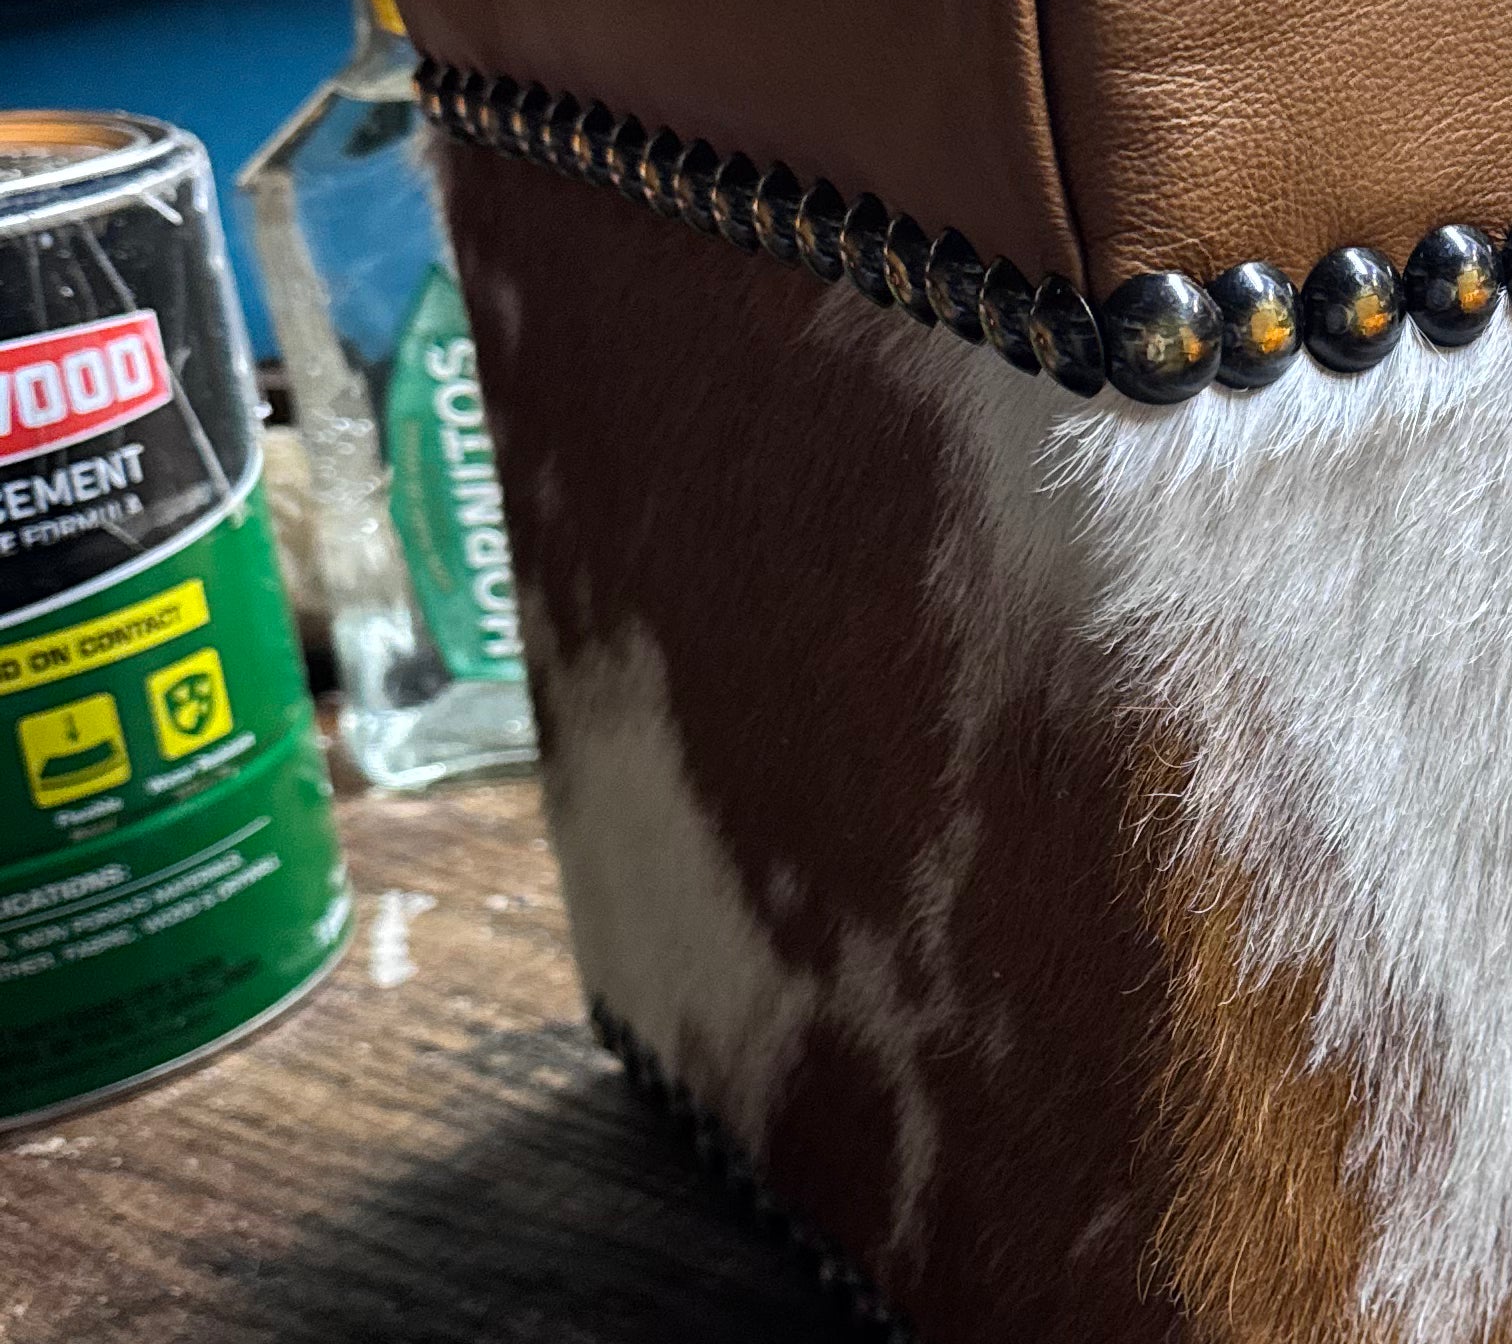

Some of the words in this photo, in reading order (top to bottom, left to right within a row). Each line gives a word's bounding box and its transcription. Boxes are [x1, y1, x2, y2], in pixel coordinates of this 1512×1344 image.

[0, 333, 153, 437] OOD
[0, 442, 145, 524] EMENT
[426, 338, 525, 657] HORNITOS
[28, 645, 71, 673] ON
[77, 605, 182, 658] CONTACT
[0, 863, 132, 919] ICATIONS:
